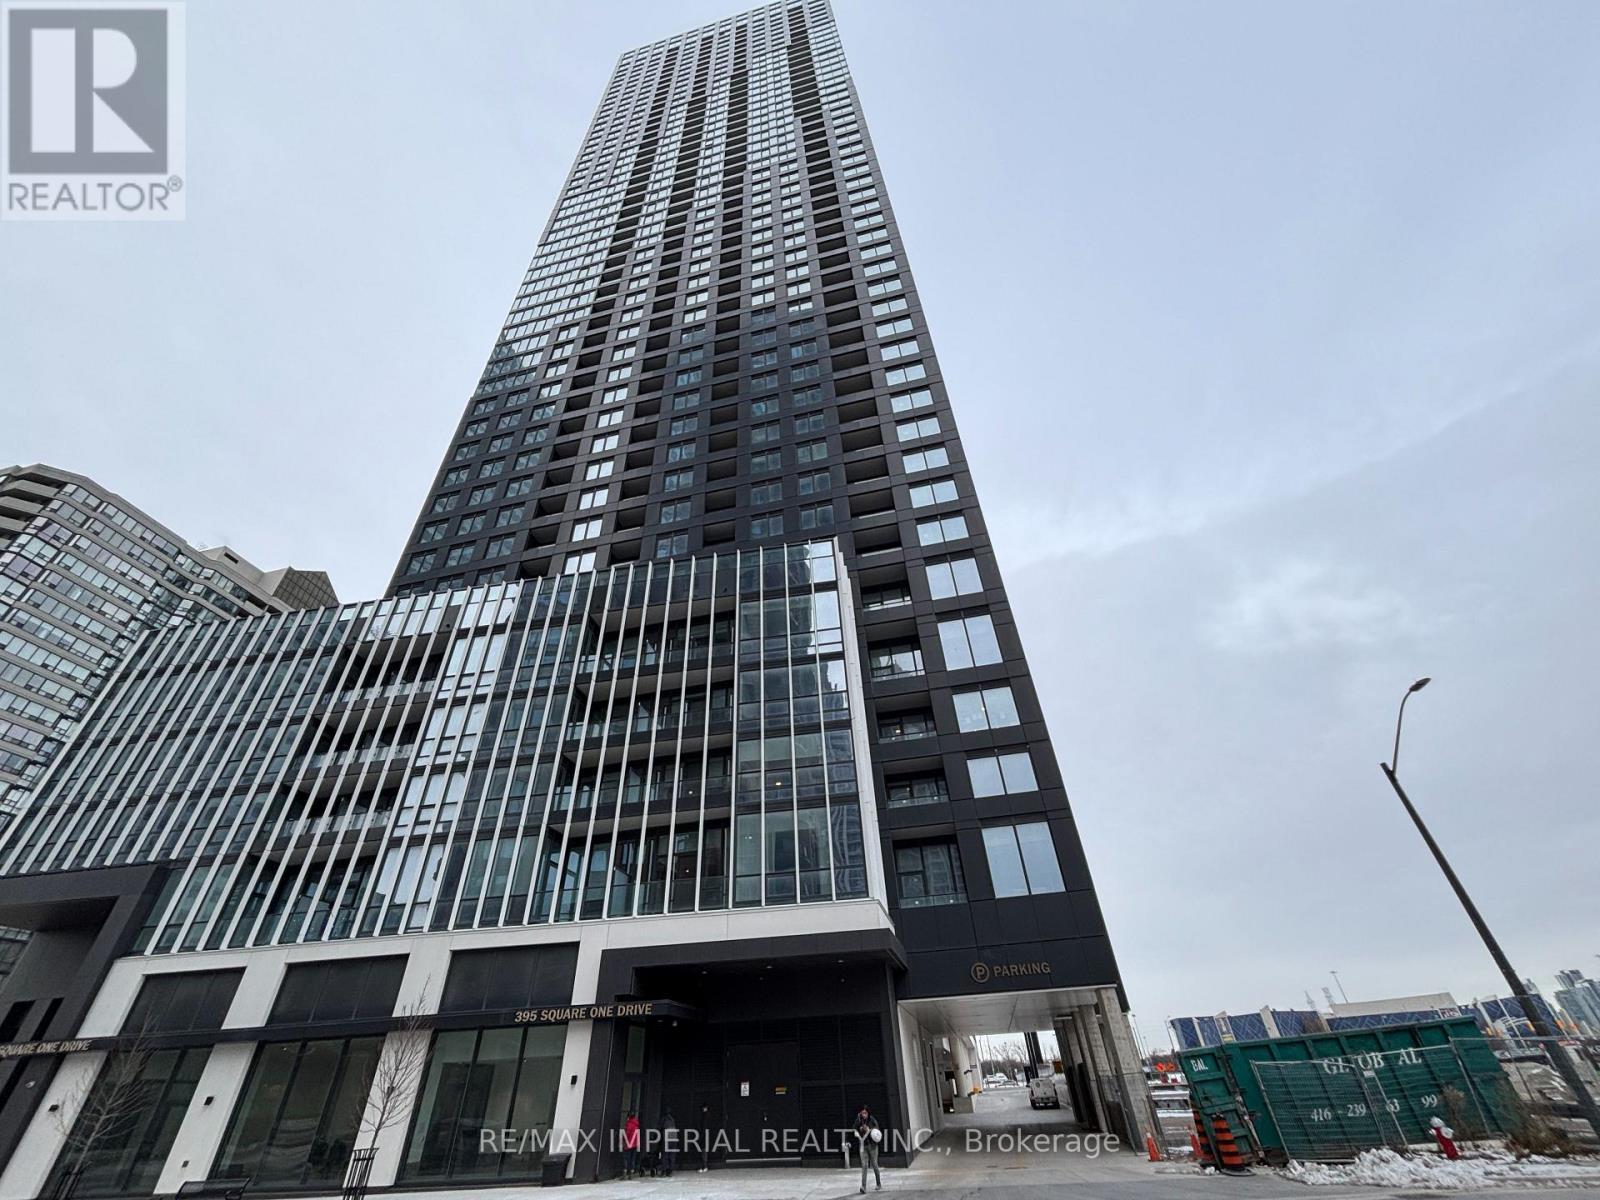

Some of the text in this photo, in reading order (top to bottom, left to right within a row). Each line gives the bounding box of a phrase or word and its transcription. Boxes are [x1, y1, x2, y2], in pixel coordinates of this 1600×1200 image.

[993, 962, 1051, 977] PARKING
[515, 1003, 652, 1022] 395 SQUARE ONE DRIVE
[36, 1041, 60, 1053] ONE
[59, 1039, 91, 1052] DRIVE
[1311, 1107, 1332, 1122] 416
[1346, 1103, 1366, 1117] 239
[1421, 1094, 1438, 1108] 99
